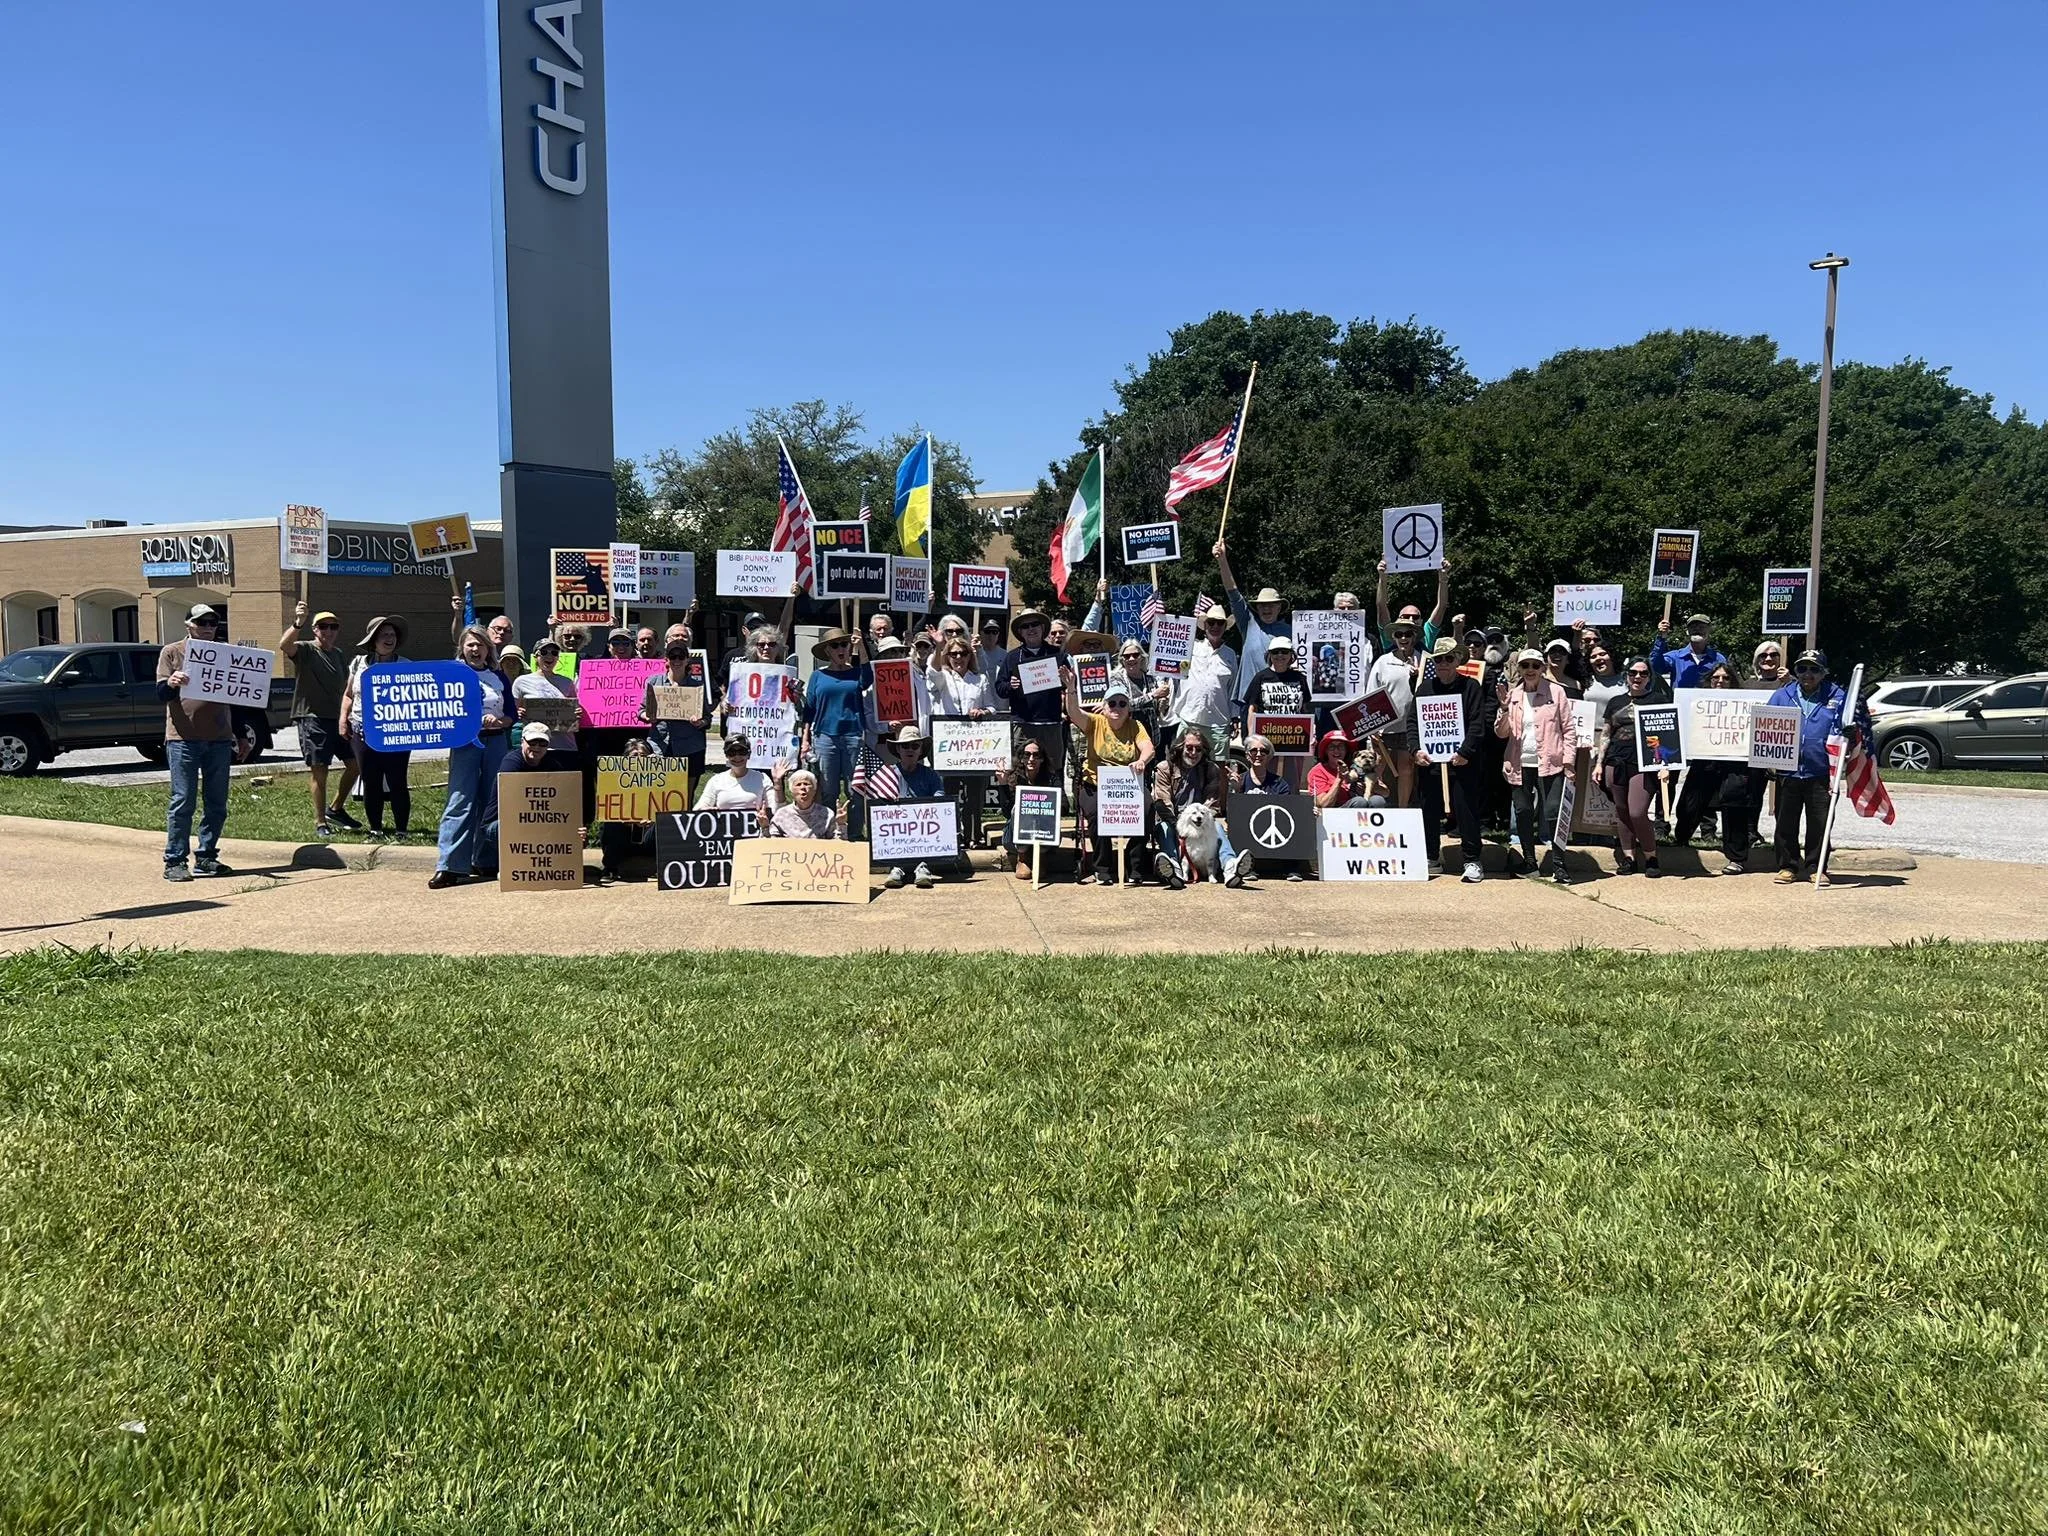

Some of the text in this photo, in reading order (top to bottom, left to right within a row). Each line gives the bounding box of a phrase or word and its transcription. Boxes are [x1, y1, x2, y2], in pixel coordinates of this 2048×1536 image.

[287, 504, 323, 519] HONK
[294, 516, 318, 528] FOR
[816, 529, 863, 545] NO ICE
[1129, 528, 1170, 539] NO KINGS
[140, 535, 229, 561] ROBINSON
[422, 542, 468, 556] RESIST
[1658, 543, 1692, 551] CRIMINALS
[661, 553, 680, 562] DUE
[191, 560, 229, 576] Dentistry
[361, 565, 389, 573] General
[393, 562, 450, 578] Dentistry
[830, 567, 841, 580] got
[843, 567, 856, 578] rule
[858, 567, 865, 578] of
[895, 568, 926, 578] IMPEACH
[614, 583, 637, 593] VOTE
[895, 578, 926, 591] CONVICT
[1769, 578, 1805, 586] DEMOCRACY
[895, 590, 926, 603] REMOVE
[958, 586, 1002, 598] PATRIOTIC
[1110, 584, 1153, 599] HONK
[558, 595, 608, 611] NOPE
[1769, 594, 1792, 602] DEFEND
[1111, 600, 1137, 613] RULE
[1557, 599, 1617, 612] ENOUGH!
[561, 613, 606, 621] SINCE 1776
[1300, 613, 1358, 621] ICE CAPTURES
[1158, 621, 1191, 632] REGIME
[1318, 622, 1352, 630] DEPORTS
[1157, 630, 1190, 640] CHANGE
[1158, 638, 1186, 648] STARTS
[1166, 647, 1187, 656] HOME
[190, 648, 267, 670] NO WAR
[1349, 631, 1360, 693] WORST
[588, 661, 666, 672] IF NOT
[1081, 666, 1105, 678] ICE
[201, 667, 251, 684] HEEL
[372, 675, 391, 684] DEAR
[877, 669, 909, 683] STOP
[202, 682, 263, 700] SPURS
[444, 682, 465, 699] DO
[1083, 684, 1107, 693] GESTAPO
[1266, 685, 1289, 693] LAND
[1269, 694, 1292, 705] HOPE
[373, 700, 468, 721] SOMETHING.
[735, 706, 785, 720] DEMOCRACY
[881, 702, 909, 715] WAR
[1421, 702, 1458, 712] REGIME
[1696, 700, 1728, 715] STOP
[590, 711, 639, 726] IMMIGR
[1354, 710, 1381, 727] RESIST
[1422, 712, 1458, 721] CHANGE
[412, 721, 434, 731] EVERY
[436, 720, 455, 730] SANE
[1262, 723, 1293, 734] silence
[1352, 714, 1390, 736] FASCISM
[1425, 720, 1456, 729] STARTS
[1755, 717, 1796, 731] IMPEACH
[742, 726, 778, 738] DECENCY
[1436, 729, 1459, 737] HOME
[1754, 730, 1795, 745] CONVICT
[383, 734, 422, 746] AMERICAN
[938, 737, 1001, 752] EMPATHY
[1710, 732, 1744, 745] WAR!
[757, 745, 787, 757] OF LAW
[1753, 744, 1794, 759] REMOVE
[599, 756, 687, 772] CONCENTRATION
[619, 772, 667, 789] CAMPS
[525, 787, 557, 798] FEED
[529, 800, 550, 811] THE
[597, 791, 642, 822] HELL
[1021, 800, 1040, 808] SPEAK
[519, 812, 570, 824] HUNGRY
[913, 808, 939, 820] WAR
[944, 808, 952, 816] IS
[1357, 811, 1385, 827] NO
[672, 811, 760, 840] VOTE
[879, 821, 940, 837] STUPID
[509, 843, 572, 855] WELCOME
[877, 844, 956, 856] UNCONSTITUTIONAL
[530, 857, 552, 868] THE
[762, 852, 844, 865] TRUMP
[751, 864, 855, 880] The WAR
[1347, 859, 1406, 875] WAR!!
[512, 870, 575, 882] STRANGER
[663, 859, 733, 889] OUT
